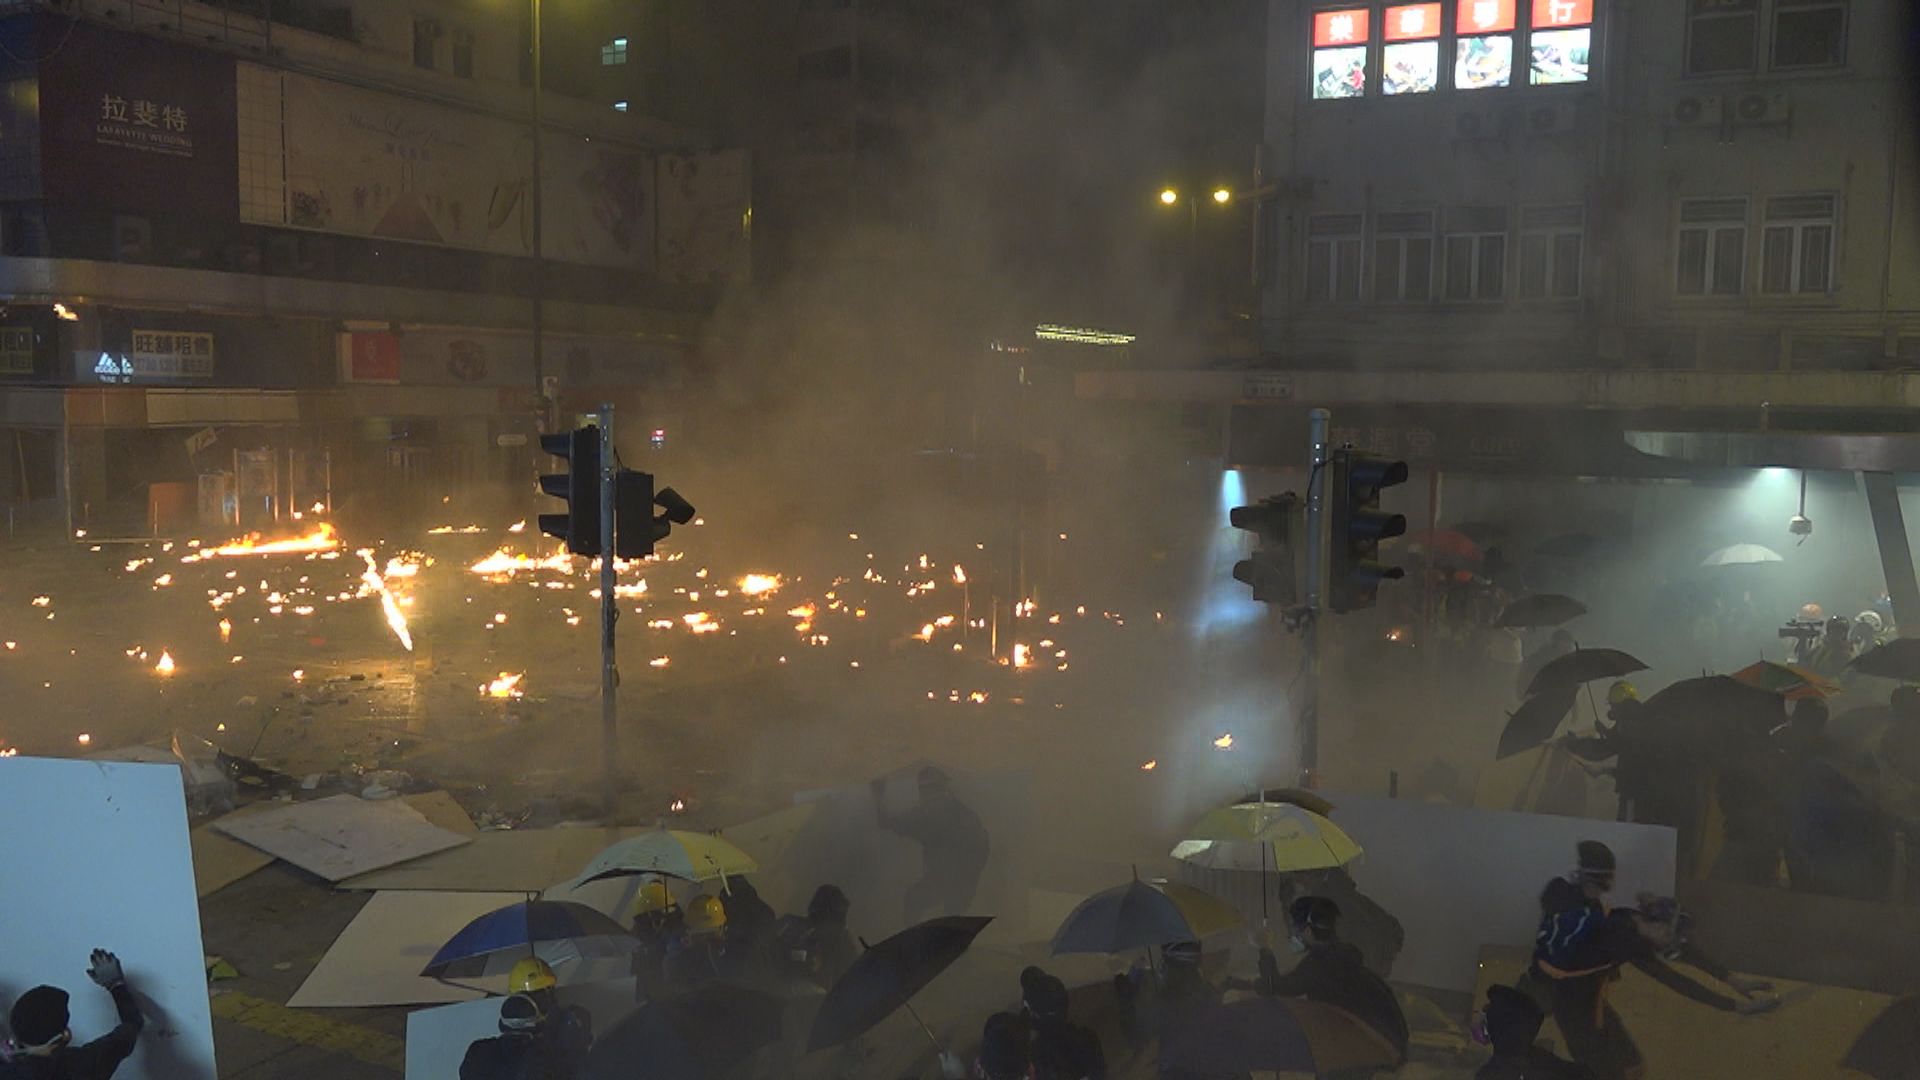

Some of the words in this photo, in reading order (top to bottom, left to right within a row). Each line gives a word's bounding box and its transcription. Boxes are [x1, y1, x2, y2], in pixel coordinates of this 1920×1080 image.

[101, 93, 188, 132] 拉斐特
[148, 133, 193, 147] WEDDING
